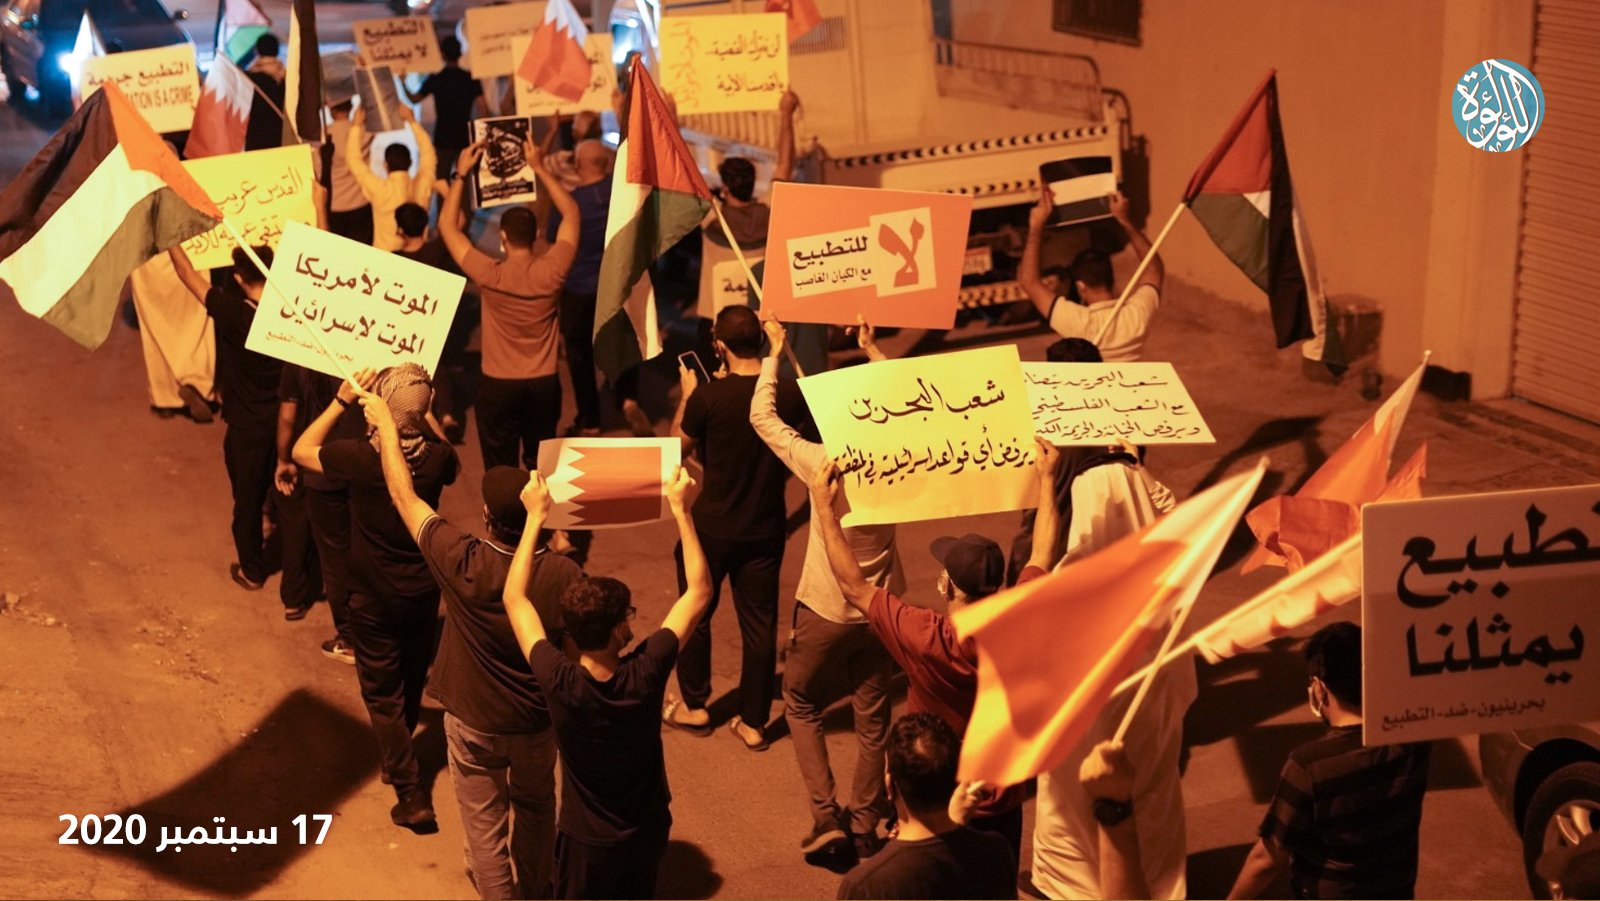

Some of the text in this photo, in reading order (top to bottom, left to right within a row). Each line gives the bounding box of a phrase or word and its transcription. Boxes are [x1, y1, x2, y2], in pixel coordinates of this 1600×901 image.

[138, 61, 190, 88] التطبيع
[169, 84, 195, 105] CRIME
[256, 165, 304, 205] القدس
[792, 235, 868, 269] للتطبيع
[878, 216, 925, 288] لا
[295, 252, 439, 316] الموت لأمريكا
[796, 266, 873, 291] مع الكيان الغاصب
[376, 322, 426, 355] الموت
[1024, 370, 1169, 393] شعب البحرين يتضا
[848, 376, 1006, 424] شعب البحرين
[1032, 394, 1190, 420] مع الشعب الفلسطيني
[1103, 419, 1142, 440] الخيانة
[972, 422, 993, 471] أي
[992, 437, 1035, 469] يرفض
[863, 451, 878, 486] في
[1406, 613, 1585, 684] يمثلنا
